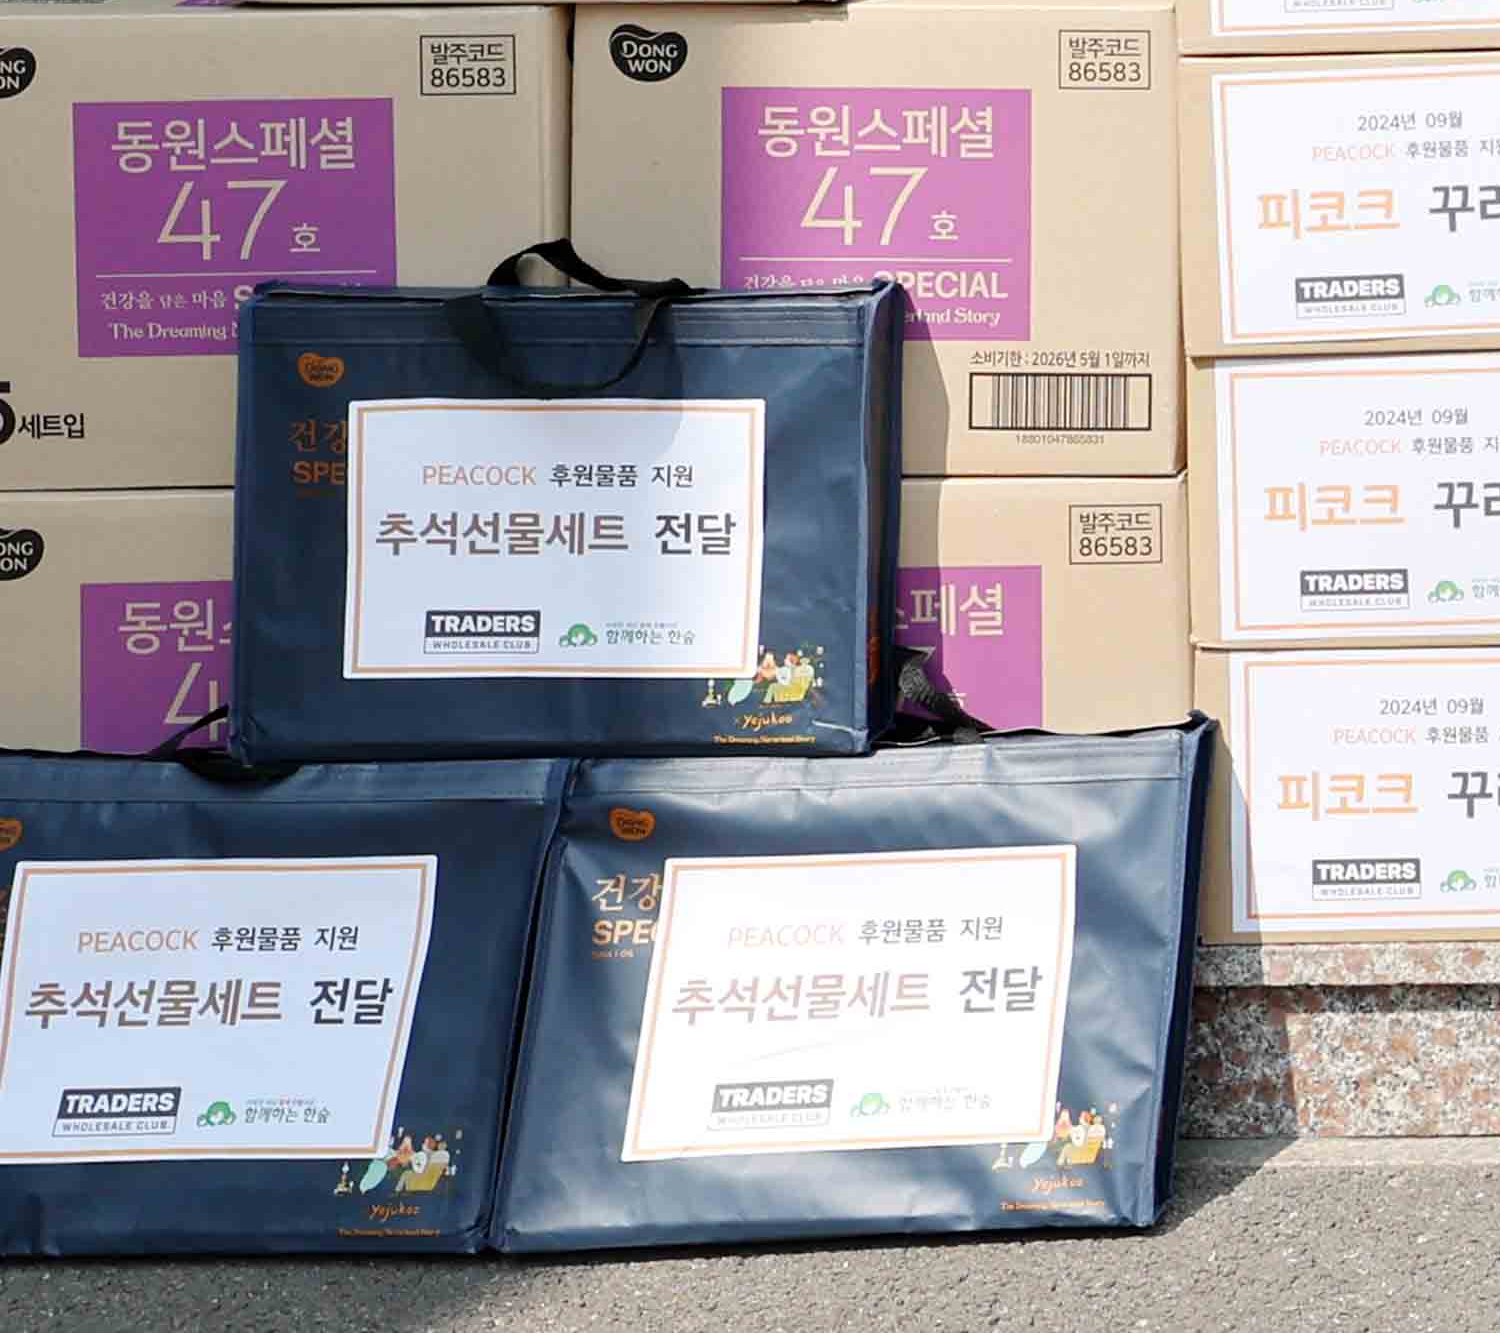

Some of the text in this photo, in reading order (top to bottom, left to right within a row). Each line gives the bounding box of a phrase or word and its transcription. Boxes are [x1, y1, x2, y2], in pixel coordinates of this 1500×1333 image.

[111, 116, 356, 174] 동원스페셜
[755, 102, 995, 162] 동원스페셜
[799, 164, 931, 246] 47
[423, 464, 693, 488] PEACOCK 후원물품 지원
[375, 511, 737, 556] 추석선물세트 전달
[431, 614, 536, 634] TRADERS
[502, 639, 533, 650] CLUB
[24, 977, 394, 1030] 추석선물세트 전달
[671, 965, 1044, 1027] 추석선물세트 전달
[64, 1091, 178, 1115] TRADERS
[717, 1083, 829, 1108] TRADERS
